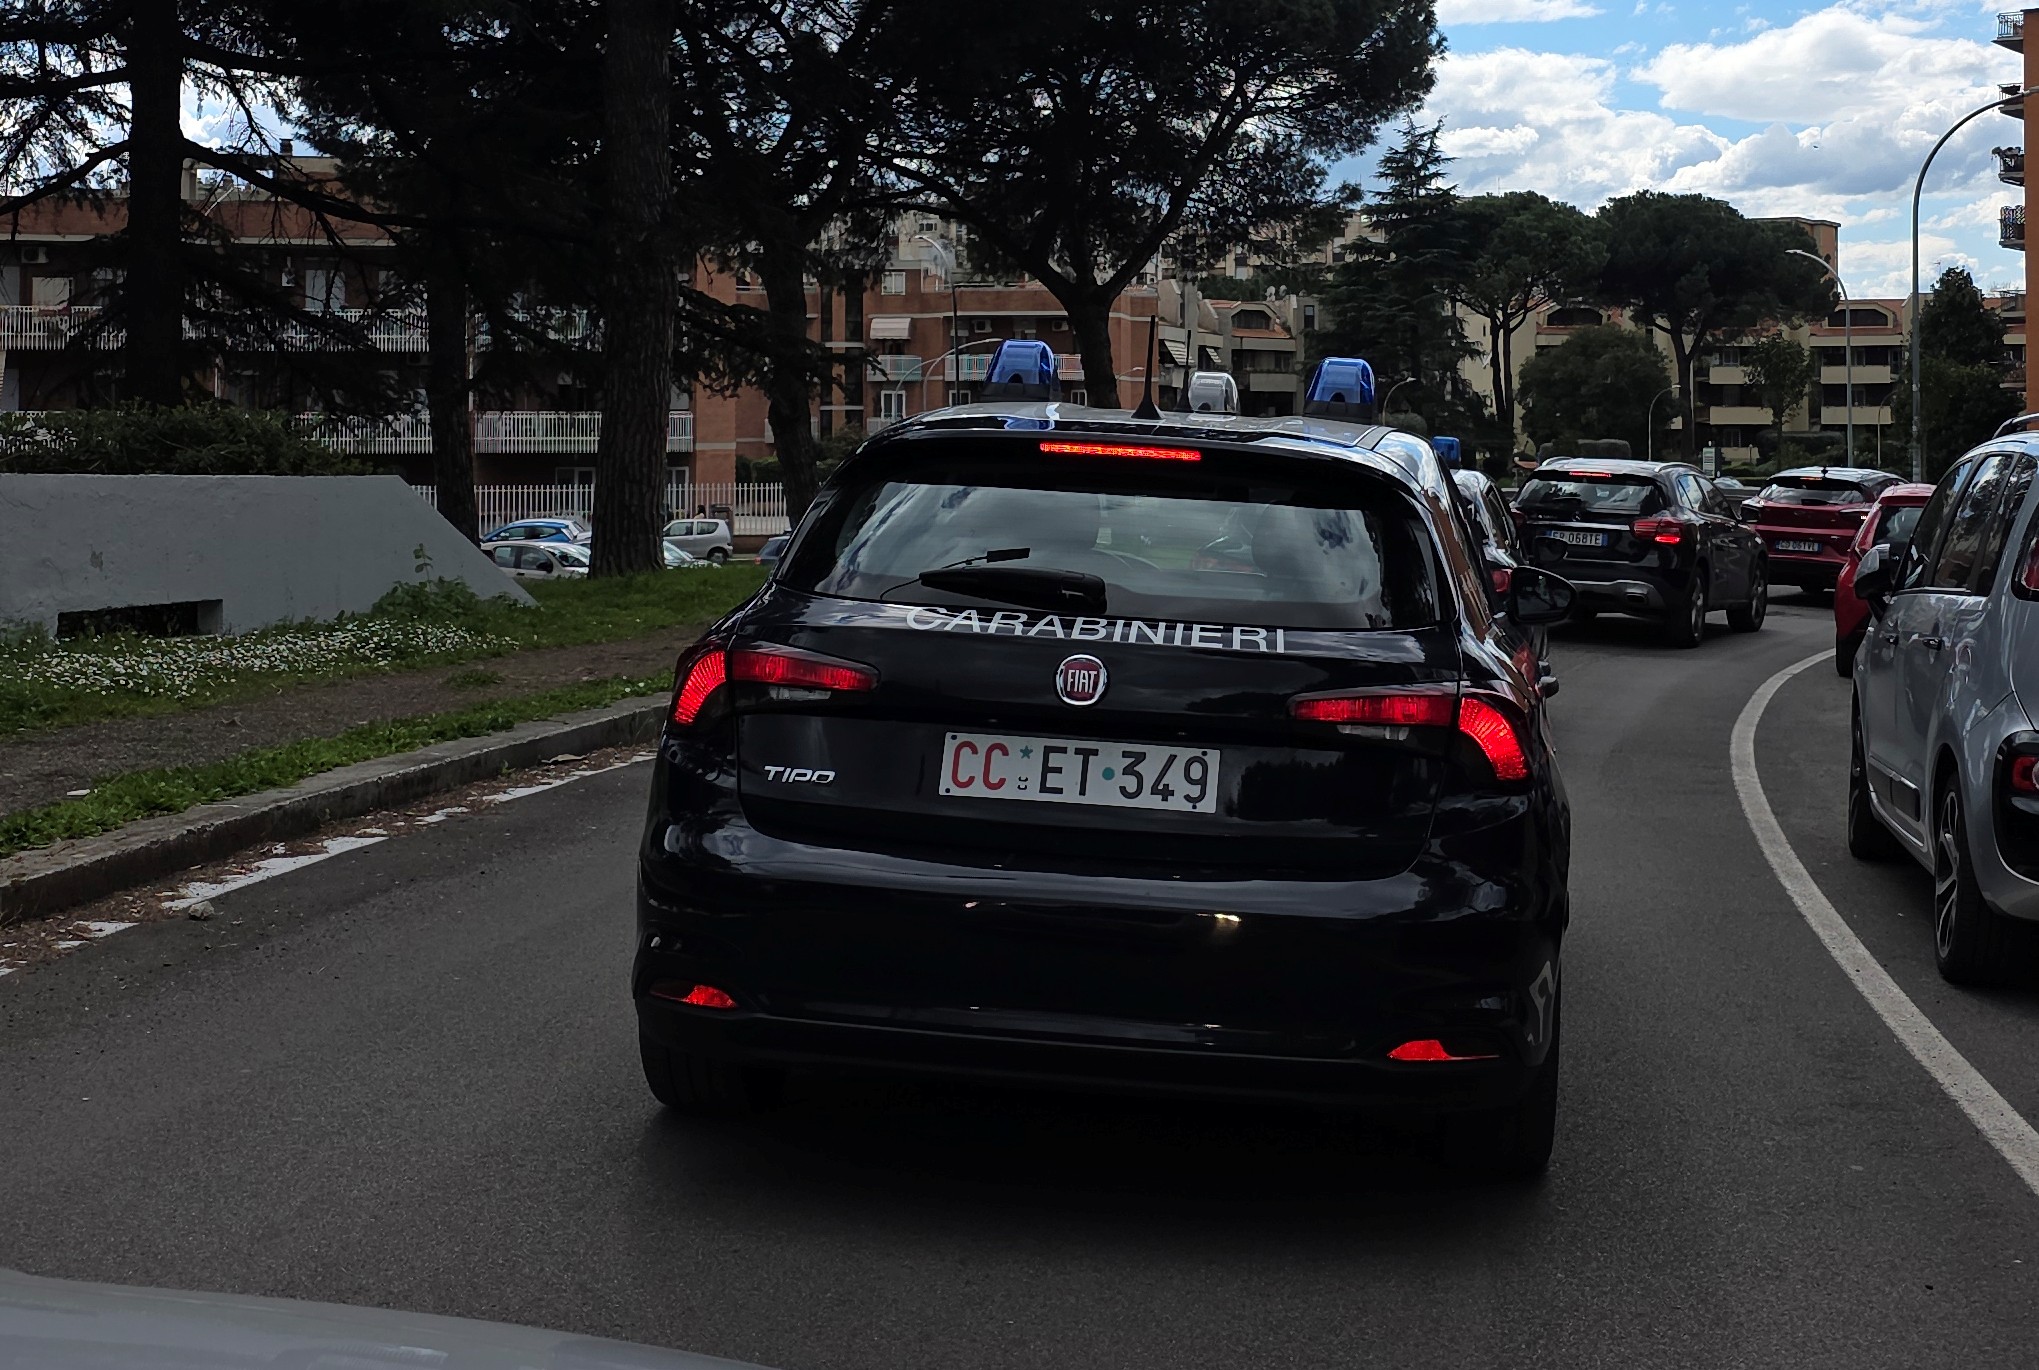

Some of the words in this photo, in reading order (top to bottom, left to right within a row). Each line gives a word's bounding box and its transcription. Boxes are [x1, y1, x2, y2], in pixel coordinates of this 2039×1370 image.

[906, 606, 1285, 653] CARABINIERI
[1066, 669, 1098, 693] FIAT
[764, 765, 836, 784] TIPO
[951, 740, 1010, 790] CC
[1039, 745, 1099, 796] ET
[1118, 750, 1209, 804] 349
